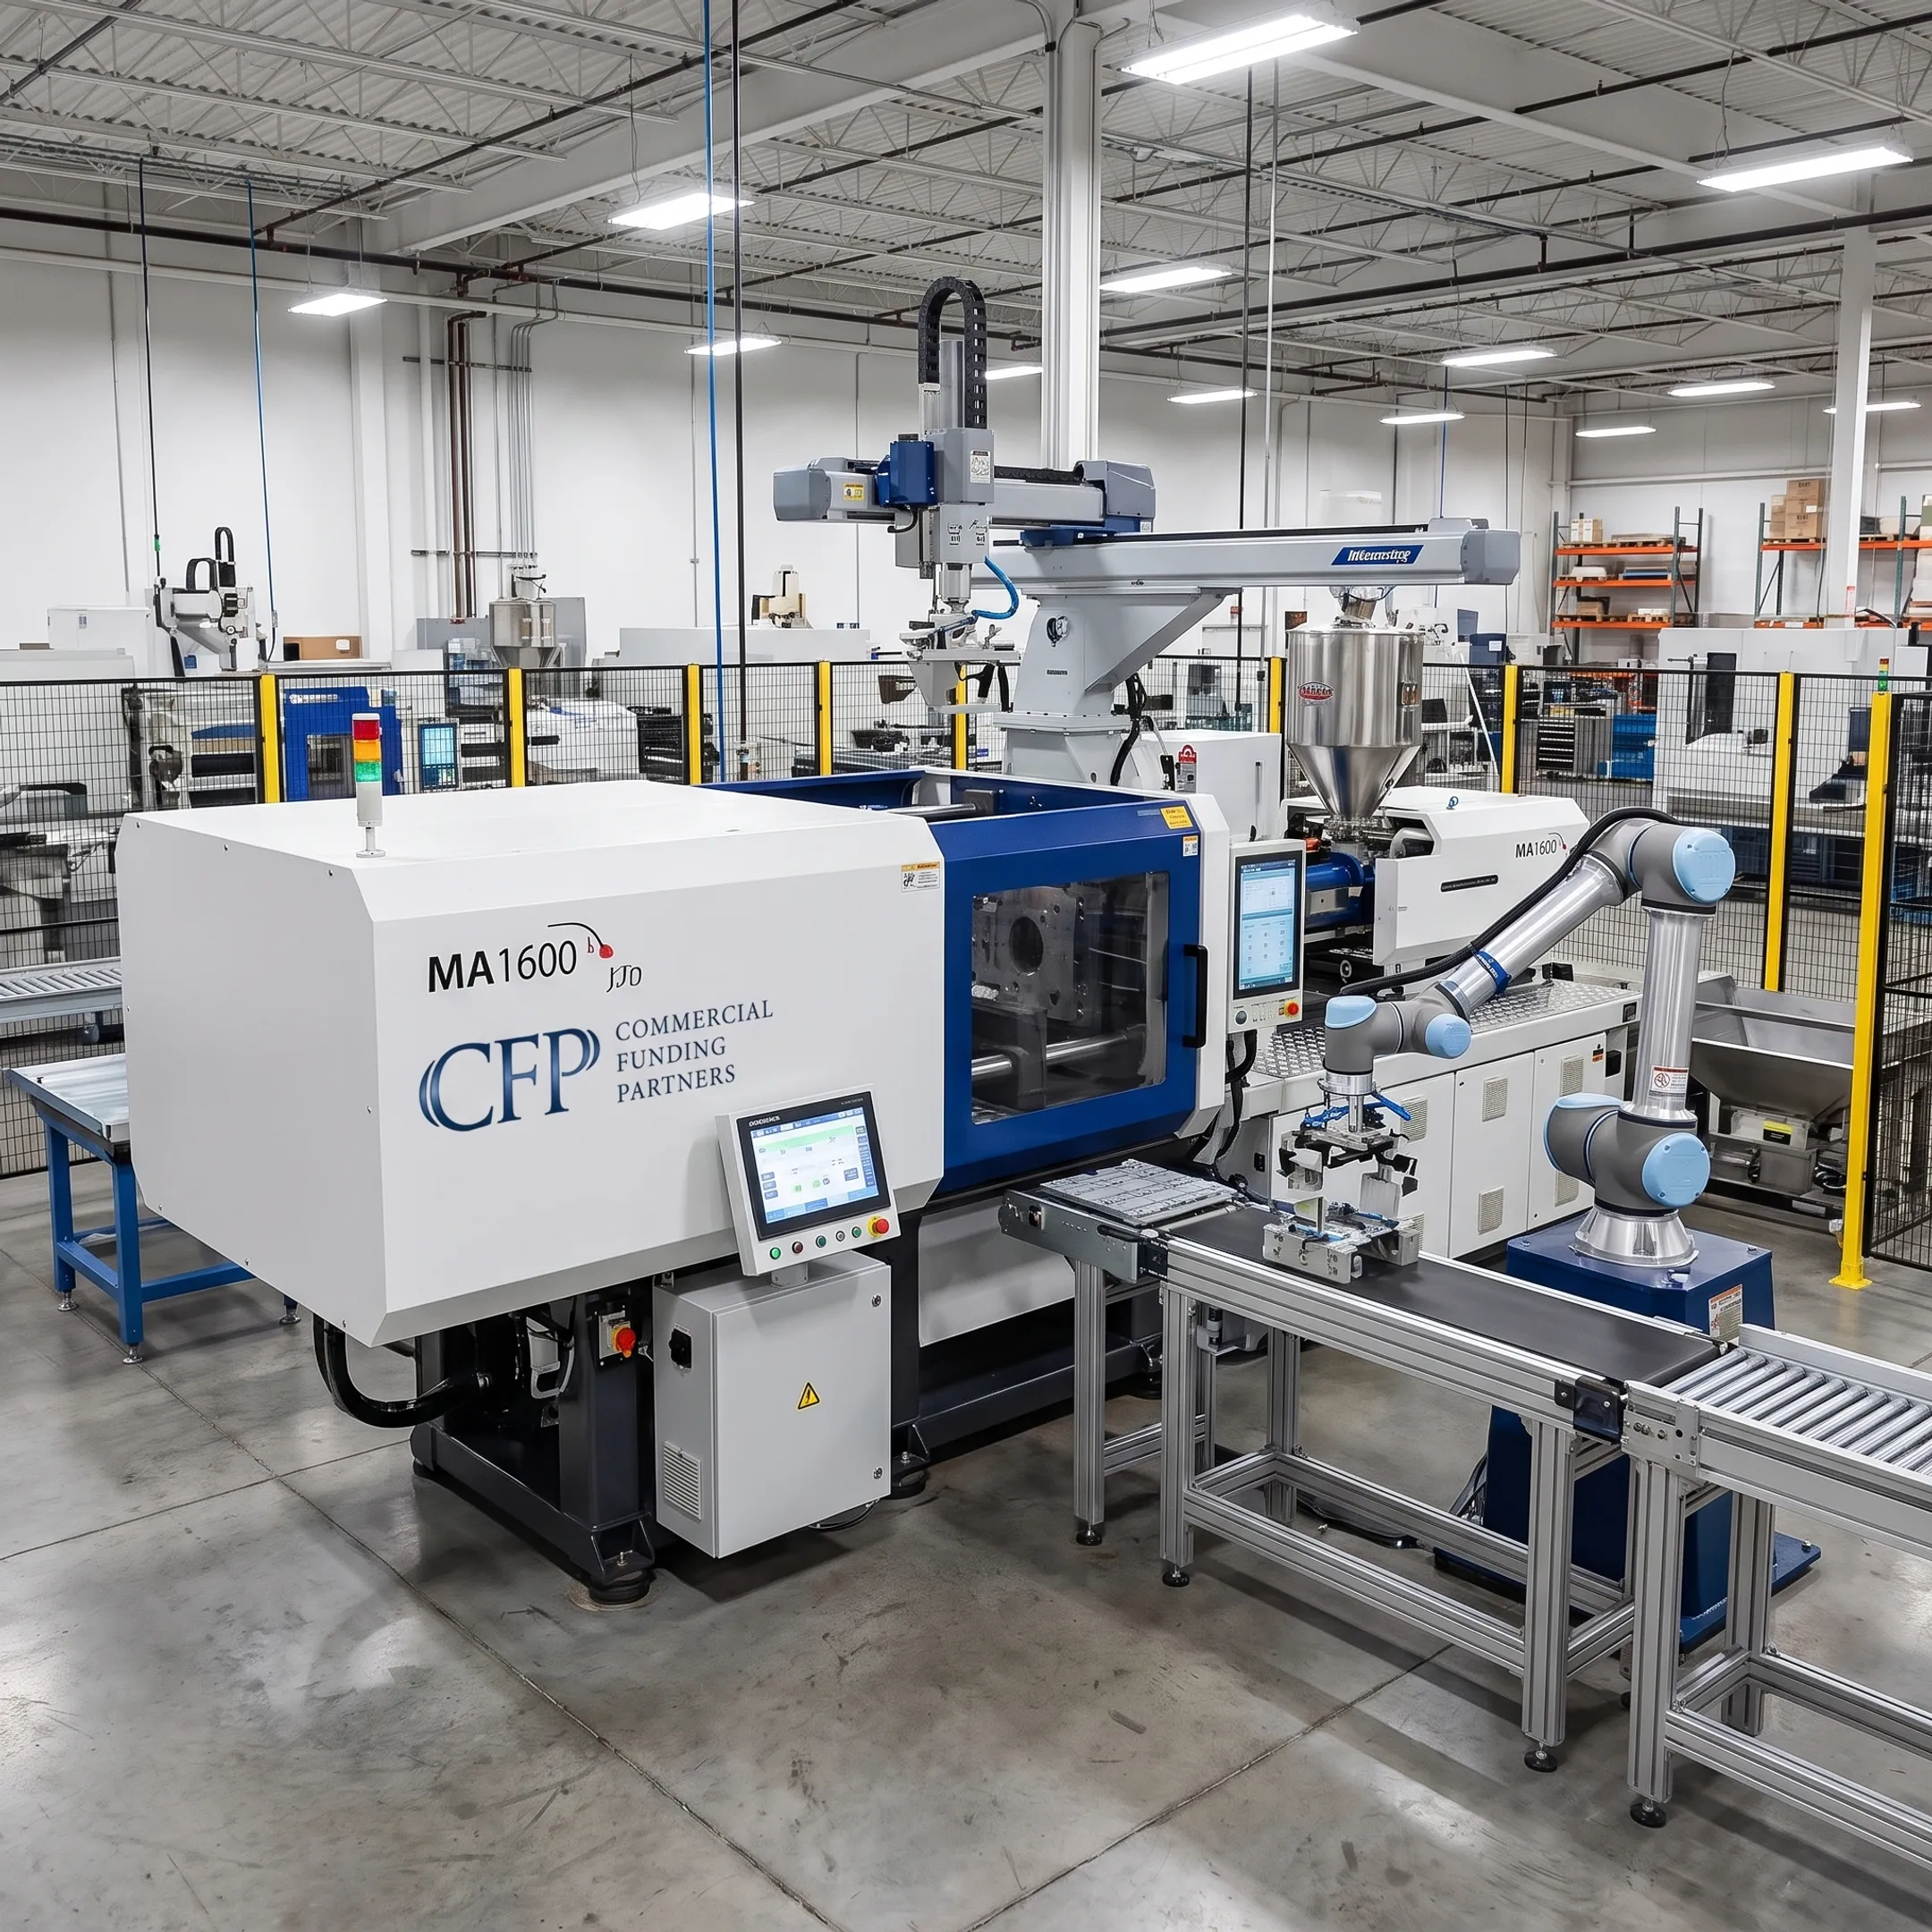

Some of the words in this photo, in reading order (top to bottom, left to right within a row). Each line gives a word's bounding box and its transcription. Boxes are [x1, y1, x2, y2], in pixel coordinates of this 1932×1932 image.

[1515, 839, 1557, 859] MA1600
[428, 940, 577, 992] MA1600
[615, 999, 774, 1041] COMMERCIAL
[616, 1037, 726, 1072] FUNDING
[419, 1028, 601, 1132] CFP
[616, 1064, 735, 1103] PARTNERS
